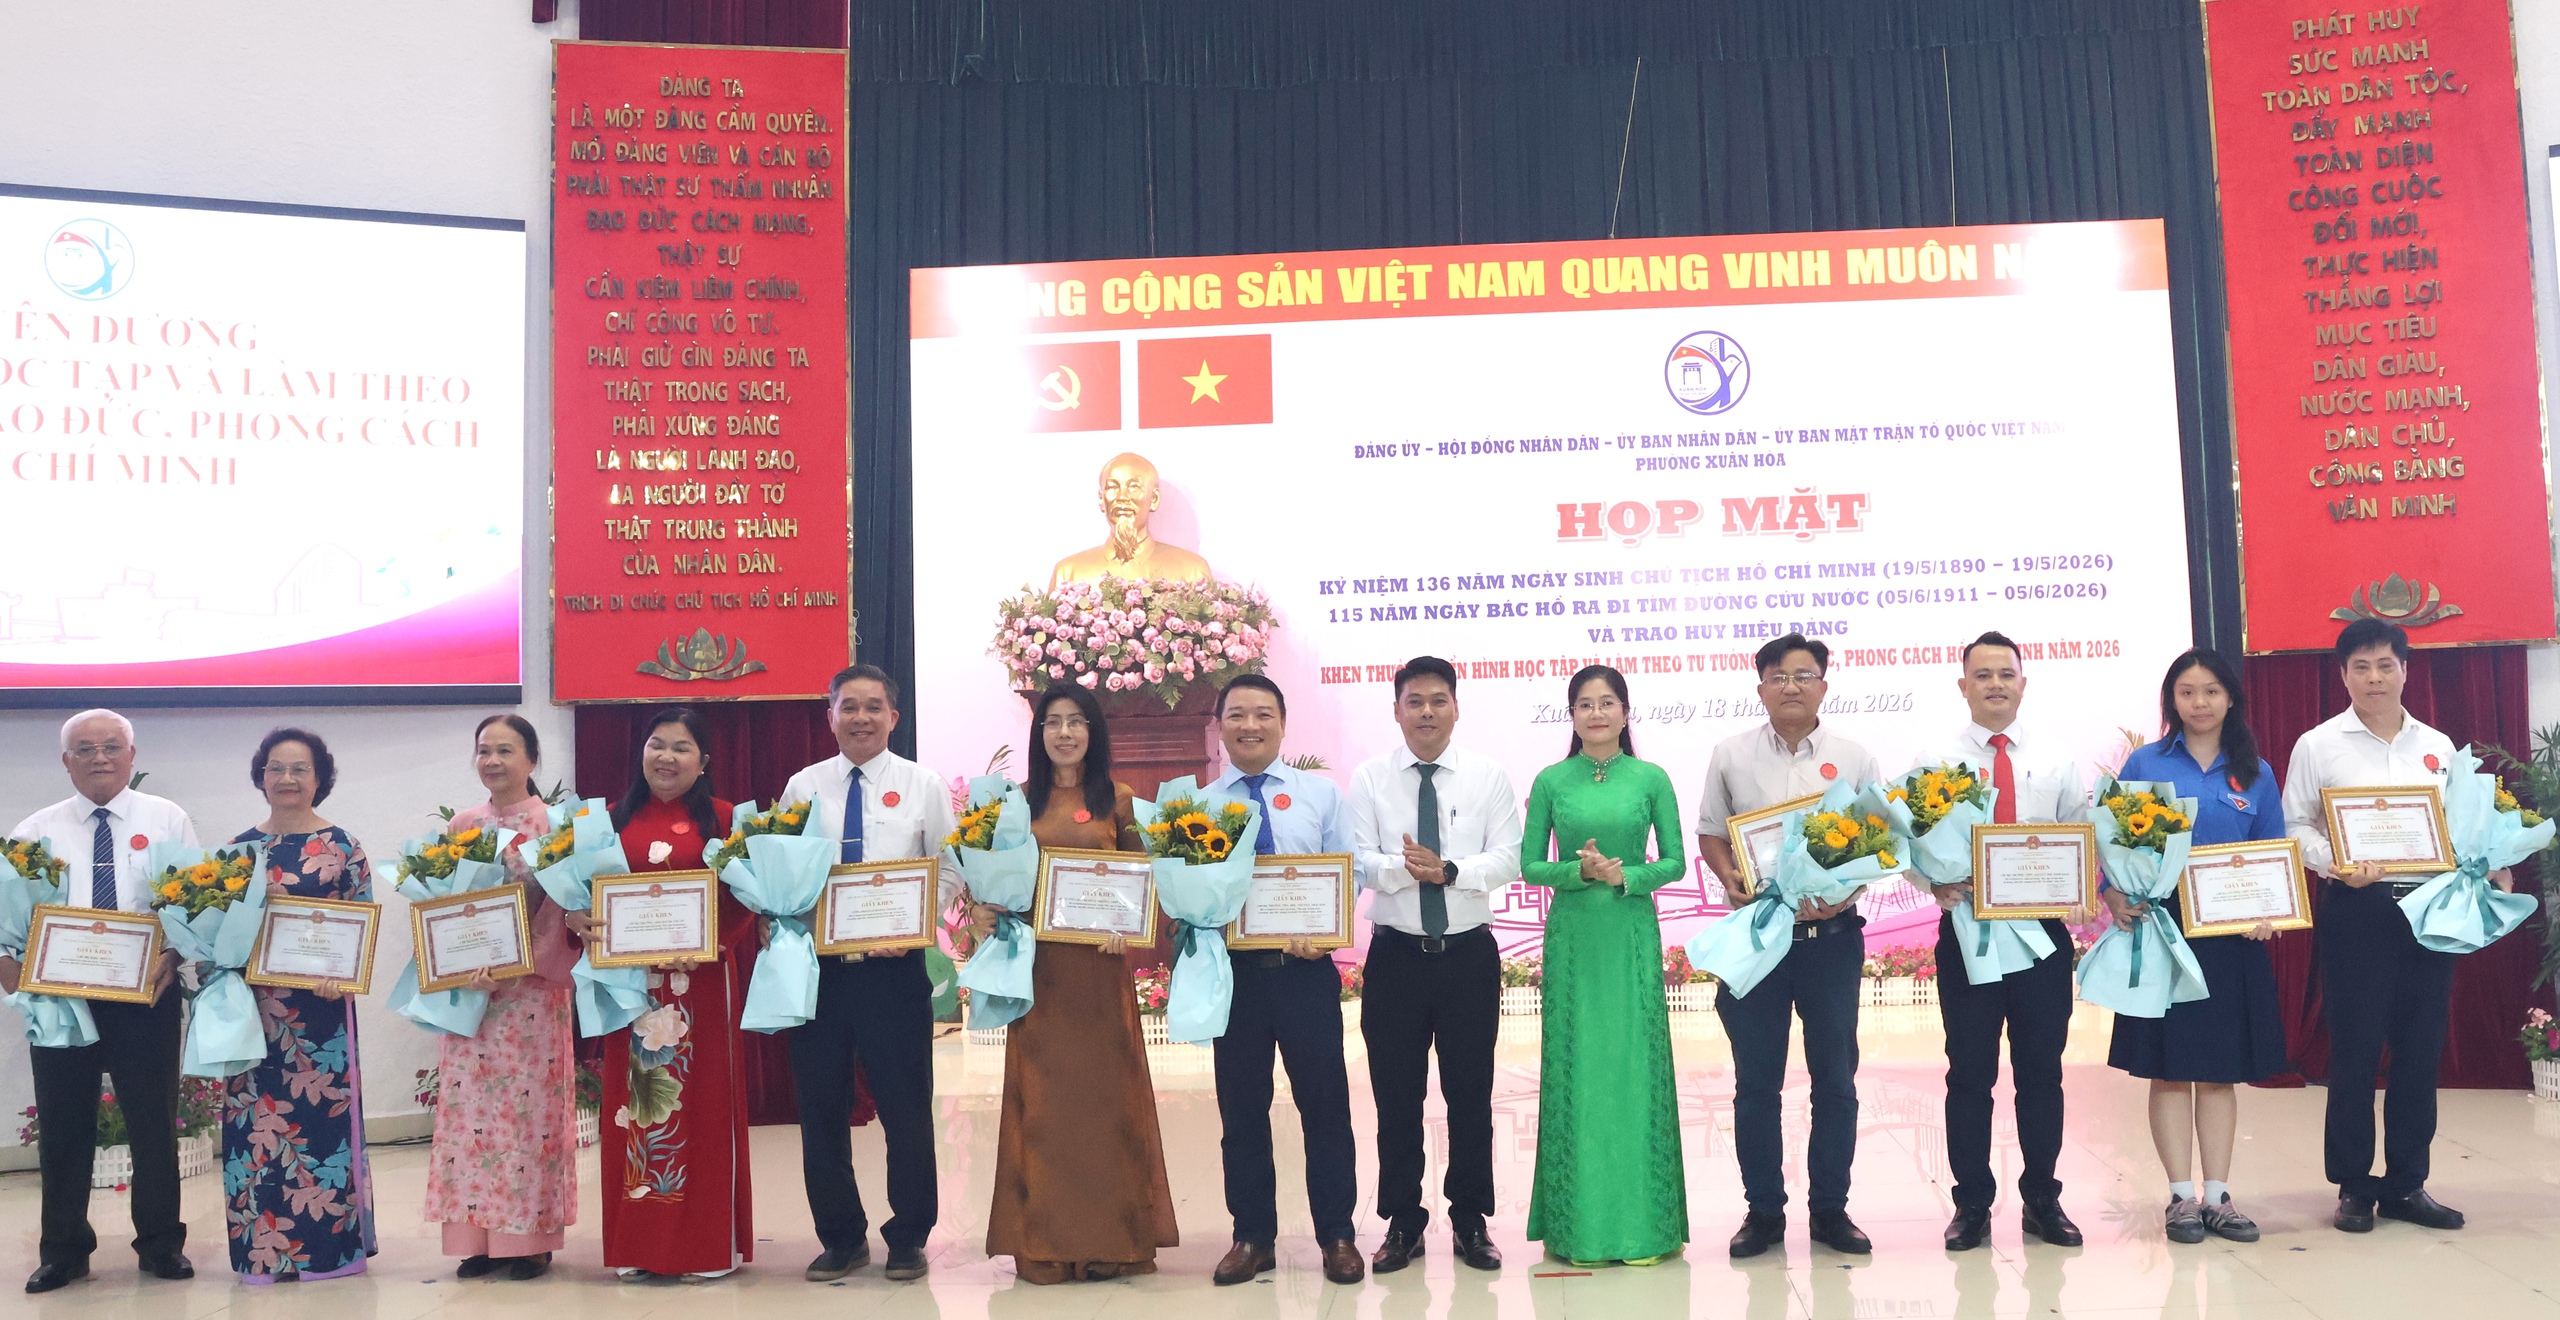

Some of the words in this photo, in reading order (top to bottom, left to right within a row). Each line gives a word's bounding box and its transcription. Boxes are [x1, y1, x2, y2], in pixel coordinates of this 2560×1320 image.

[2292, 9, 2355, 40] PHÁT
[2368, 6, 2420, 31] HUY
[2289, 47, 2339, 75] SỨC
[2352, 38, 2429, 72] MẠNH
[660, 71, 711, 97] ĐẢNG
[722, 78, 744, 97] TA
[2262, 82, 2331, 111] TOÀN
[2340, 76, 2394, 103] DÂN
[2404, 67, 2468, 101] TỘC,
[570, 102, 595, 128] LÀ
[605, 103, 645, 134] MỘT
[655, 103, 707, 130] ĐẢNG
[716, 103, 756, 131] CẦM
[2354, 108, 2431, 139] MẠNH
[2294, 145, 2362, 175] TOÀN
[2376, 139, 2433, 171] DIỆN
[2289, 184, 2359, 211] CÔNG
[2372, 172, 2442, 204] CUỘC
[2314, 210, 2357, 243] ĐỔI
[2370, 208, 2427, 239] MỚI,
[2303, 251, 2370, 278] THỰC
[2382, 242, 2438, 275] HIỆN
[1028, 279, 1087, 318] NG
[1101, 269, 1222, 320] CỘNG
[1238, 262, 1323, 309] SẢN
[1337, 258, 1432, 308] VIỆT
[1446, 260, 1546, 300] NAM
[1561, 254, 1709, 298] QUANG
[1722, 249, 1831, 289] VINH
[1846, 240, 1979, 285] MUÔN
[2403, 280, 2442, 309] LỢI
[605, 307, 637, 332] CHÍ
[646, 307, 698, 333] CÔNG
[711, 308, 737, 333] VÔ
[2316, 322, 2372, 351] MỤC
[2384, 312, 2437, 341] TIÊU
[2313, 354, 2366, 382] DÂN
[2378, 348, 2445, 377] GIÀU,
[353, 373, 471, 404] THEO
[604, 376, 653, 407] THẬT
[665, 381, 729, 402] TRONG
[738, 380, 792, 406] SẠCH,
[2301, 386, 2373, 416] NƯỚC
[2386, 385, 2470, 415] MẠNH,
[190, 410, 345, 444] PHONG
[360, 410, 479, 447] CÁCH
[1354, 441, 1397, 459] ĐẢNG
[1402, 440, 1421, 457] ỦY
[1438, 439, 1467, 458] HỘI
[1471, 435, 1515, 455] ĐỒNG
[1520, 436, 1563, 453] NHÂN
[1568, 434, 1600, 451] DÂN
[1618, 432, 1636, 450] ỦY
[1641, 434, 1673, 449] BAN
[1678, 430, 1720, 447] NHÂN
[1725, 429, 1757, 446] DÂN
[1775, 427, 1794, 444] ỦY
[1798, 429, 1830, 443] BAN
[1835, 426, 1868, 445] MẶT
[1874, 424, 1915, 443] TRẬN
[1920, 420, 1940, 439] TỔ
[1945, 419, 1987, 441] QUỐC
[1991, 420, 2026, 439] VIỆT
[2032, 422, 2065, 435] NAM
[2324, 422, 2379, 451] DÂN
[2392, 414, 2455, 448] CHỦ,
[12, 444, 95, 482] CHÍ
[117, 453, 237, 485] MINH
[1636, 454, 1701, 471] PHƯỜNG
[1705, 452, 1749, 469] XUÂN
[1754, 450, 1786, 467] HÒA
[2309, 458, 2383, 487] CÔNG
[2394, 448, 2465, 481] BẰNG
[645, 478, 707, 505] NGƯỜI
[2328, 494, 2378, 522] VĂN
[2392, 494, 2456, 518] MINH
[604, 515, 651, 544] THẬT
[663, 519, 726, 540] TRUNG
[735, 512, 798, 539] THÀNH
[1556, 500, 1702, 547] HỌP
[1721, 486, 1870, 542] MẶT
[623, 548, 660, 576] CỦA
[674, 548, 727, 576] NHÂN
[738, 548, 783, 575] DÂN.
[1320, 576, 1346, 595] KỶ
[1353, 576, 1409, 596] NIỆM
[1416, 577, 1451, 592] 136
[1458, 573, 1505, 591] NĂM
[1512, 570, 1568, 589] NGÀY
[1574, 571, 1624, 587] SINH
[1631, 566, 1672, 585] CHỦ
[1680, 567, 1730, 586] TỊCH
[1738, 560, 1767, 581] HỒ
[1774, 562, 1811, 580] CHÍ
[1818, 562, 1876, 578] MINH
[1884, 558, 1986, 579] (19/5/1890
[2012, 554, 2114, 572] 19/5/2026)
[564, 591, 603, 612] TRÍCH
[610, 595, 624, 611] DI
[630, 588, 667, 610] CHÚC
[676, 588, 704, 609] CHỦ
[712, 593, 742, 613] TỊCH
[750, 586, 770, 608] HỒ
[776, 586, 799, 607] CHÍ
[804, 590, 839, 607] MINH
[1329, 608, 1363, 623] 115
[1370, 604, 1417, 622] NĂM
[1424, 602, 1480, 620] NGÀY
[1486, 600, 1529, 617] BÁC
[1536, 596, 1566, 616] HỒ
[1573, 600, 1601, 615] RA
[1607, 599, 1631, 614] ĐI
[1636, 594, 1678, 612] TÌM
[1684, 592, 1758, 612] ĐƯỜNG
[1765, 590, 1805, 609] CỨU
[1812, 588, 1869, 607] NƯỚC
[1876, 587, 1979, 608] (05/6/1911
[2004, 583, 2108, 601] 05/6/2026)
[1588, 625, 1615, 643] VÀ
[1622, 626, 1678, 642] TRAO
[1685, 624, 1726, 640] HUY
[1733, 620, 1782, 641] HIỆU
[1790, 617, 1848, 636] ĐẢNG
[1320, 665, 1361, 684] KHEN
[1472, 658, 1510, 679] HÌNH
[1514, 660, 1545, 681] HỌC
[1550, 655, 1579, 681] TẬP
[1642, 655, 1682, 674] THEO
[1687, 653, 1705, 672] TƯ
[1845, 648, 1897, 667] PHONG
[1902, 644, 1942, 665] CÁCH
[2048, 638, 2082, 660] NĂM
[2087, 640, 2120, 659] 2026
[1649, 700, 1697, 723] ngày
[1702, 698, 1727, 718] 18
[1864, 692, 1913, 714] 2026
